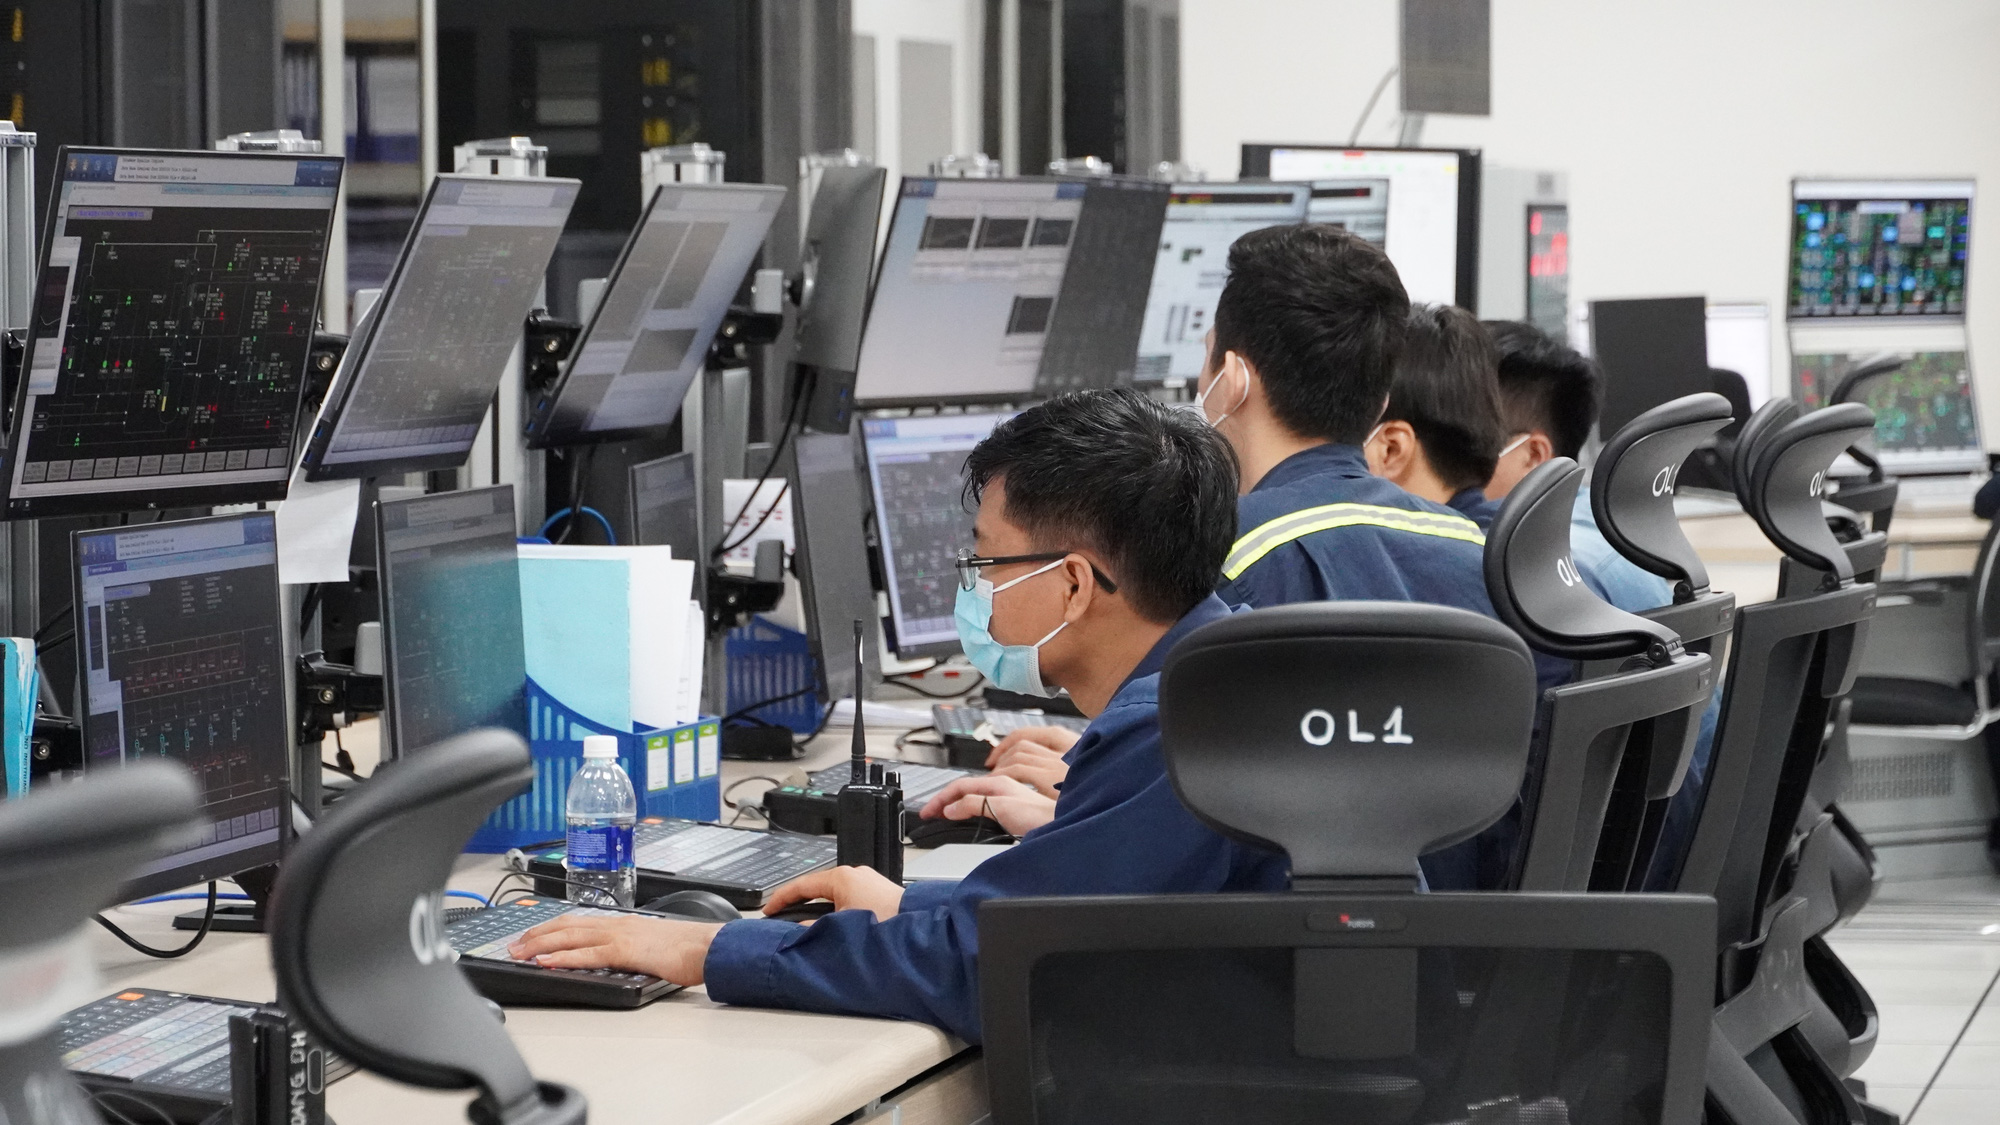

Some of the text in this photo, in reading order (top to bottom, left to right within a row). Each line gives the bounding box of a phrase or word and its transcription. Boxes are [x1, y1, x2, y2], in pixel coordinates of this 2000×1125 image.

[1810, 469, 1826, 497] OL
[1557, 555, 1582, 587] OL
[1300, 705, 1414, 746] OL1
